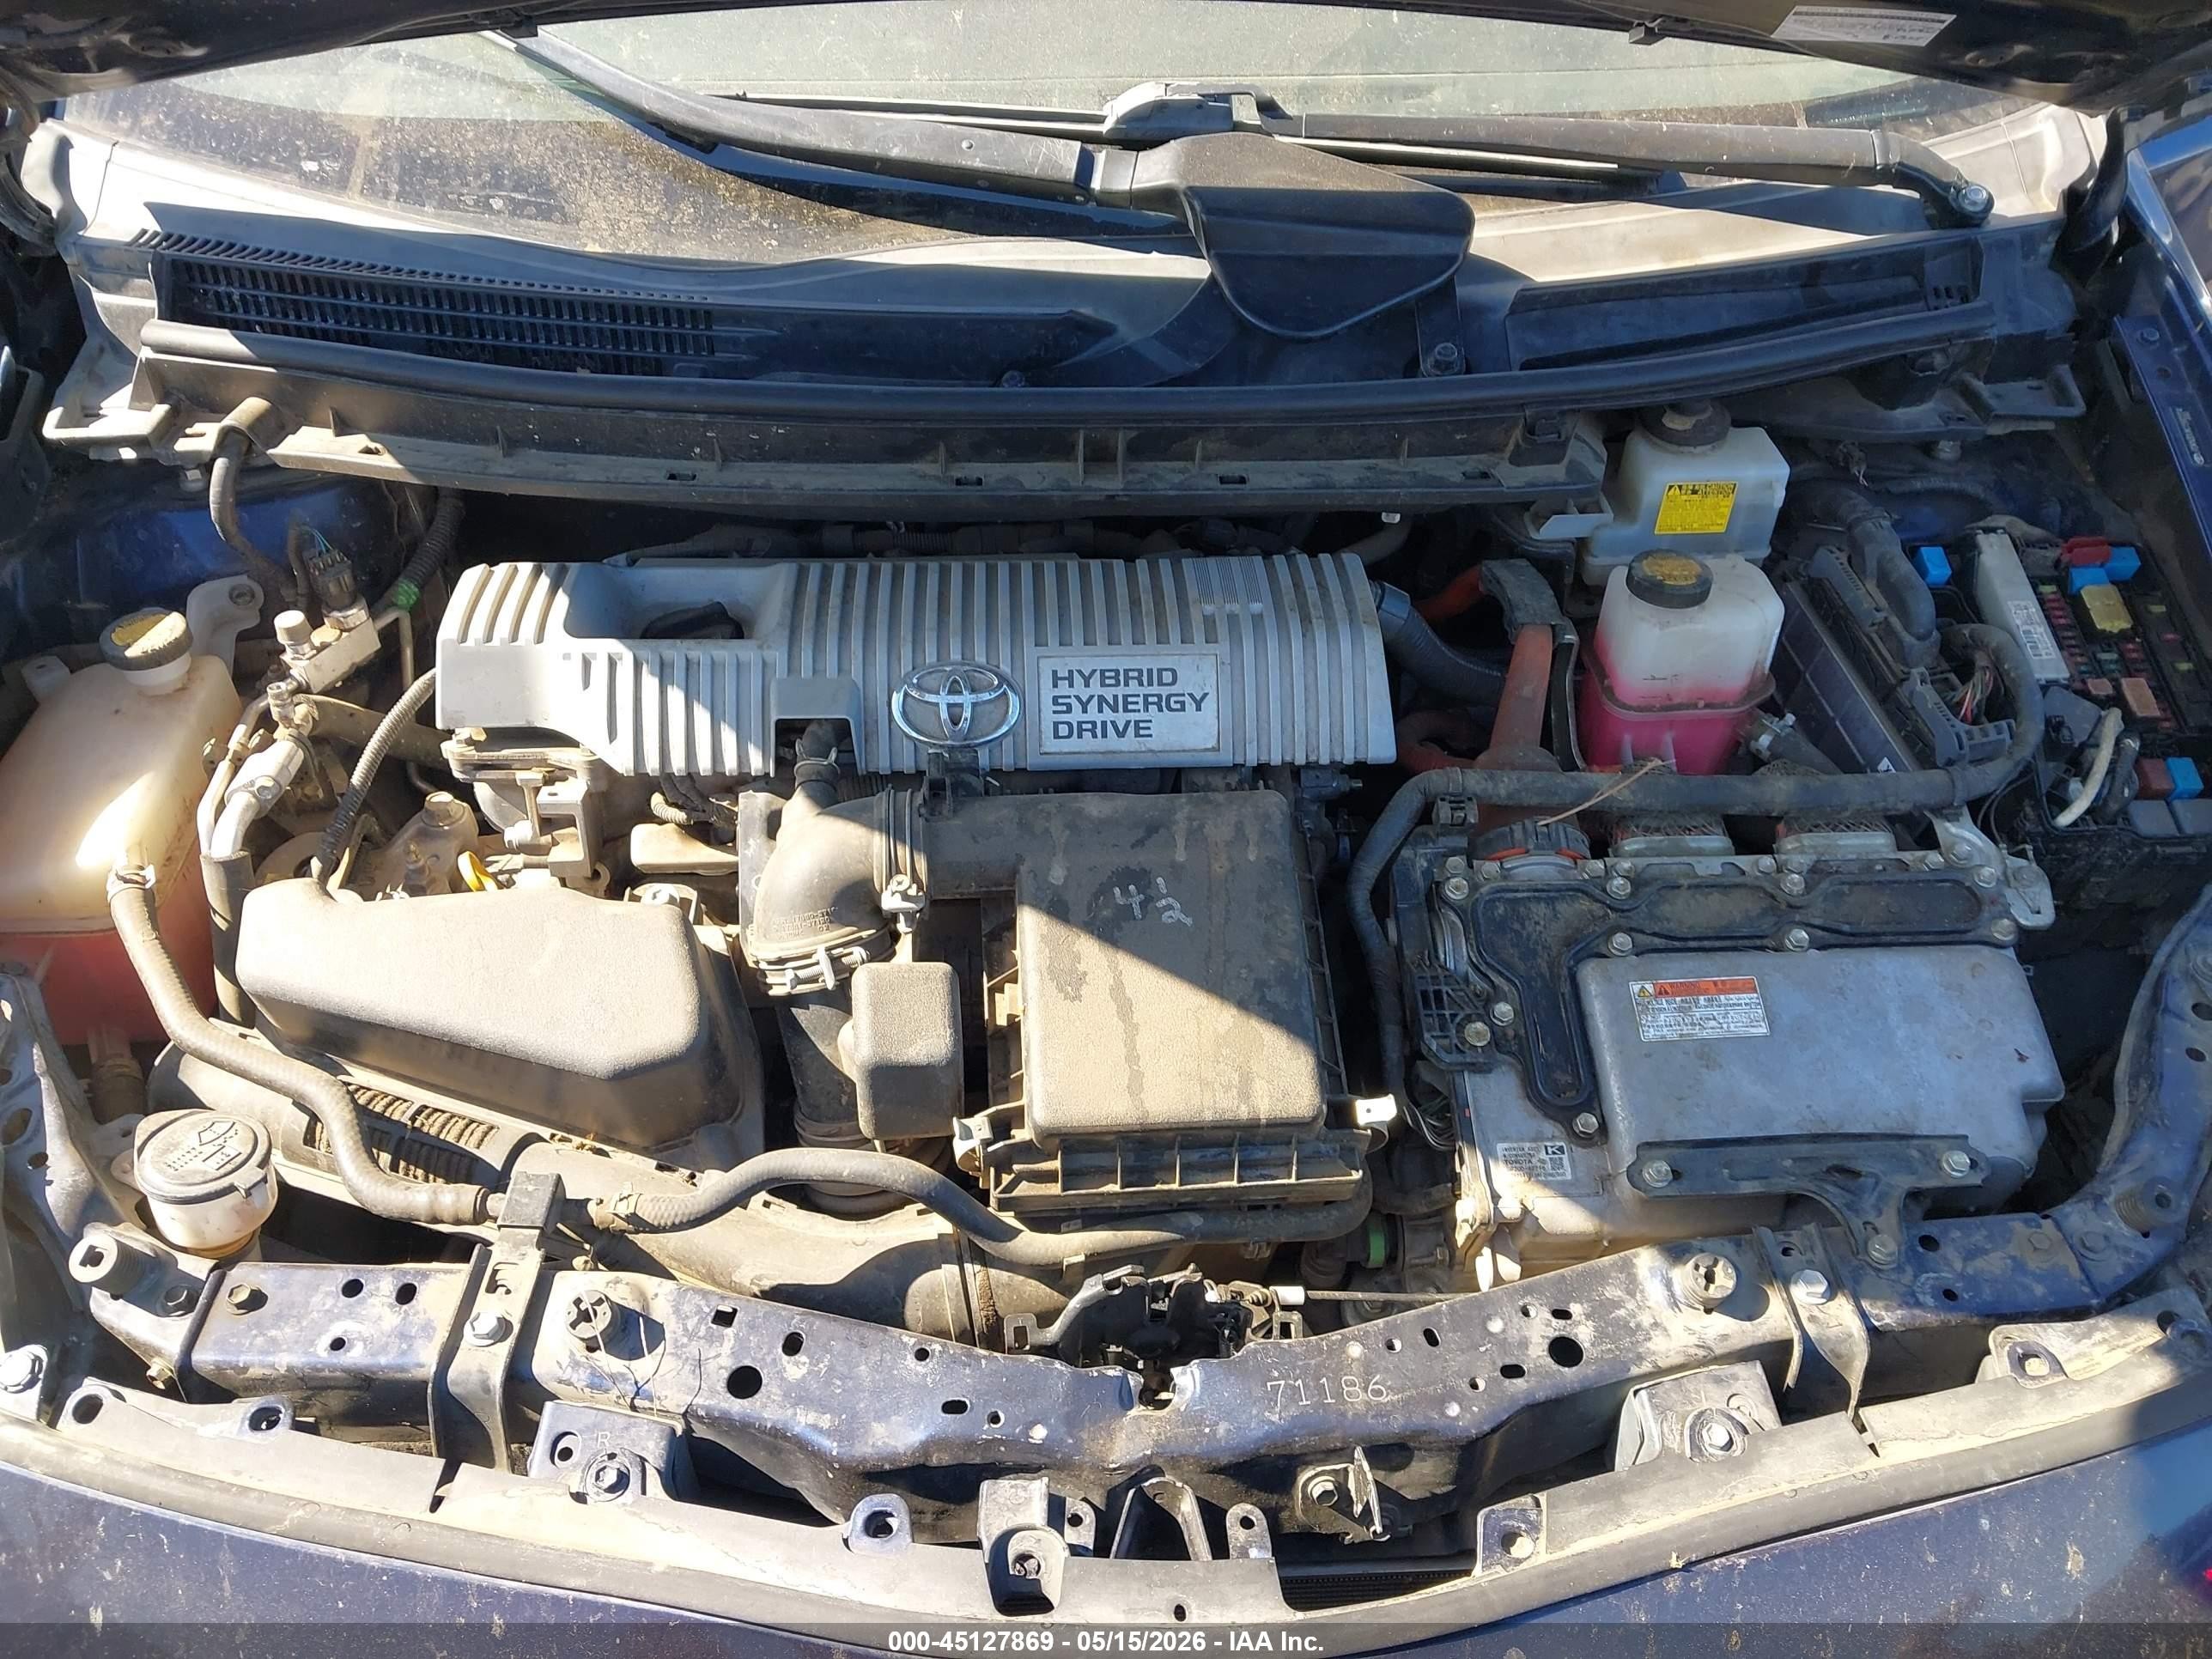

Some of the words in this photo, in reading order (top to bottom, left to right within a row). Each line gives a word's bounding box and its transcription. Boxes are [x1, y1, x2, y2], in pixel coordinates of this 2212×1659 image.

[1051, 667, 1178, 689] HYBRID
[1052, 692, 1210, 714] SYNERGY
[1053, 719, 1153, 739] DRIVE
[1267, 1375, 1388, 1413] 71186
[597, 1431, 611, 1449] R
